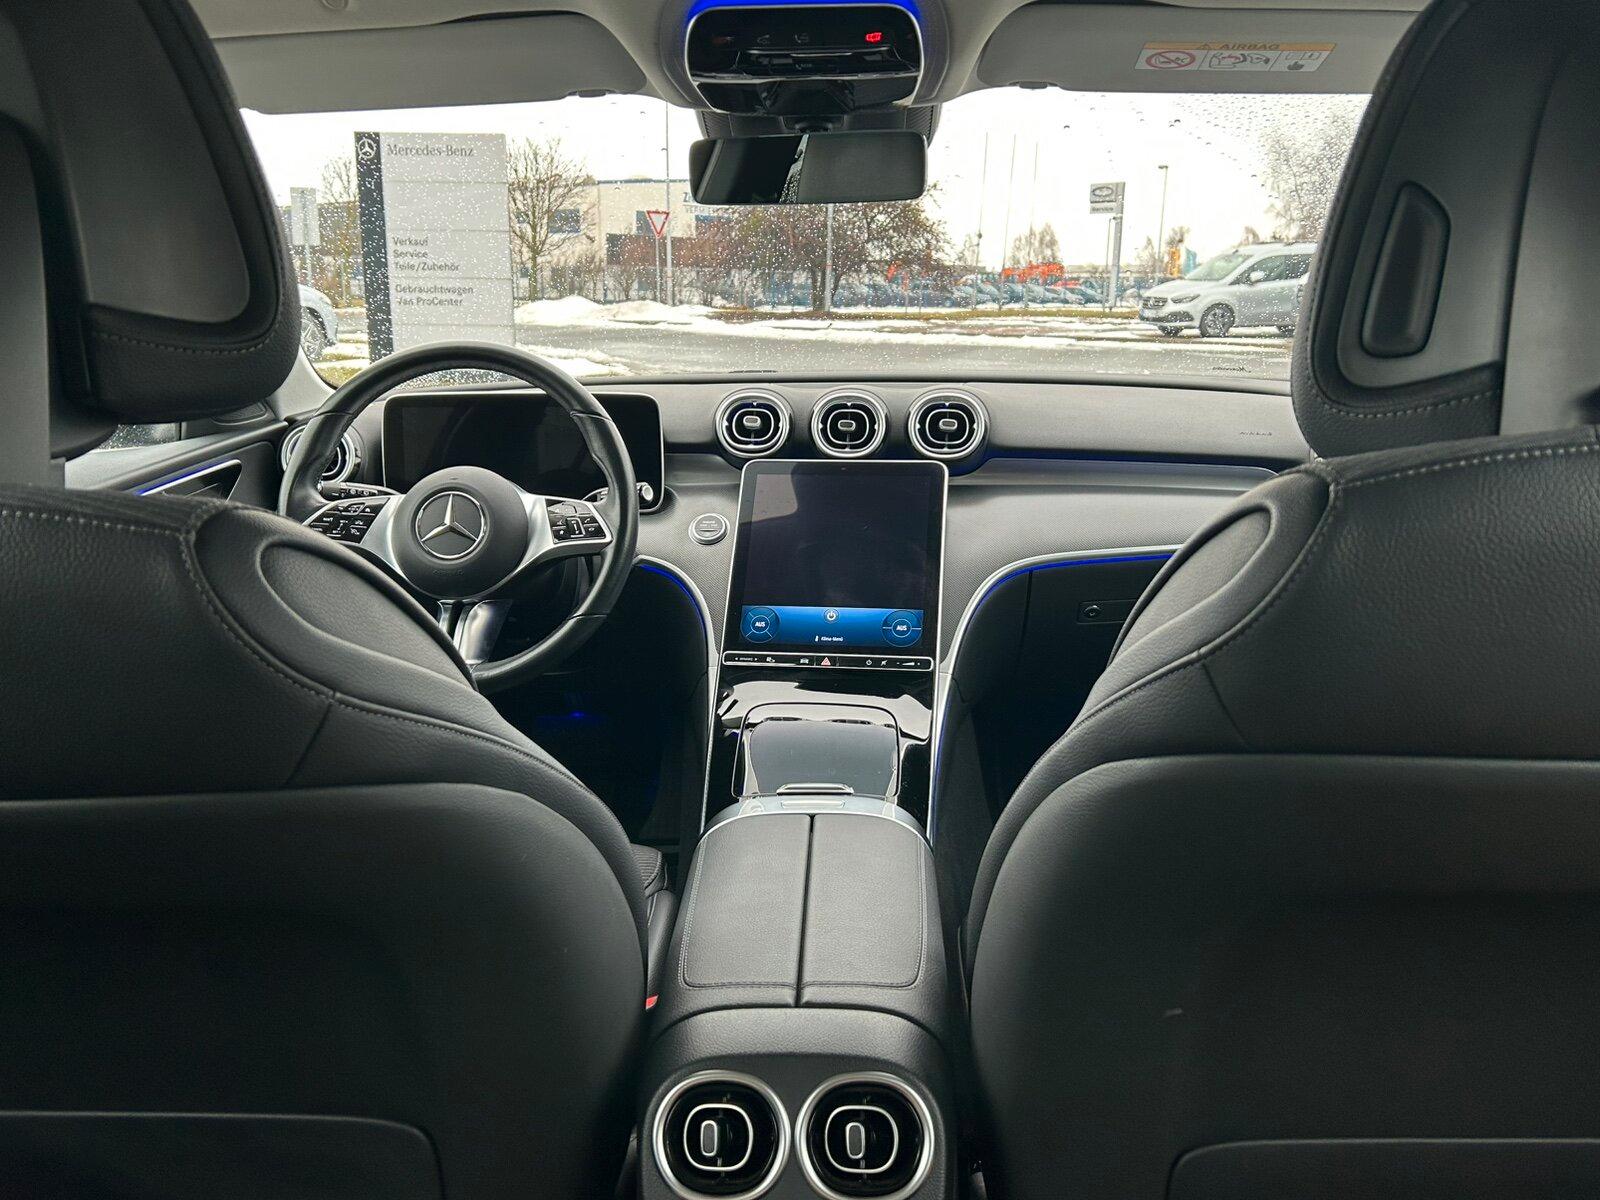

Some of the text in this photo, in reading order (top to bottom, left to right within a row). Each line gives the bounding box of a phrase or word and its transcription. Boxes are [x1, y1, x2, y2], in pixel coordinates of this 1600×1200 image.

[386, 143, 475, 158] Mercedes-Benz
[392, 237, 429, 247] Verkauf
[393, 249, 429, 259] Service
[395, 284, 474, 296] Gebrauchtwagen
[416, 297, 464, 307] ProCenter
[754, 621, 767, 629] AUS
[896, 624, 908, 632] AUS
